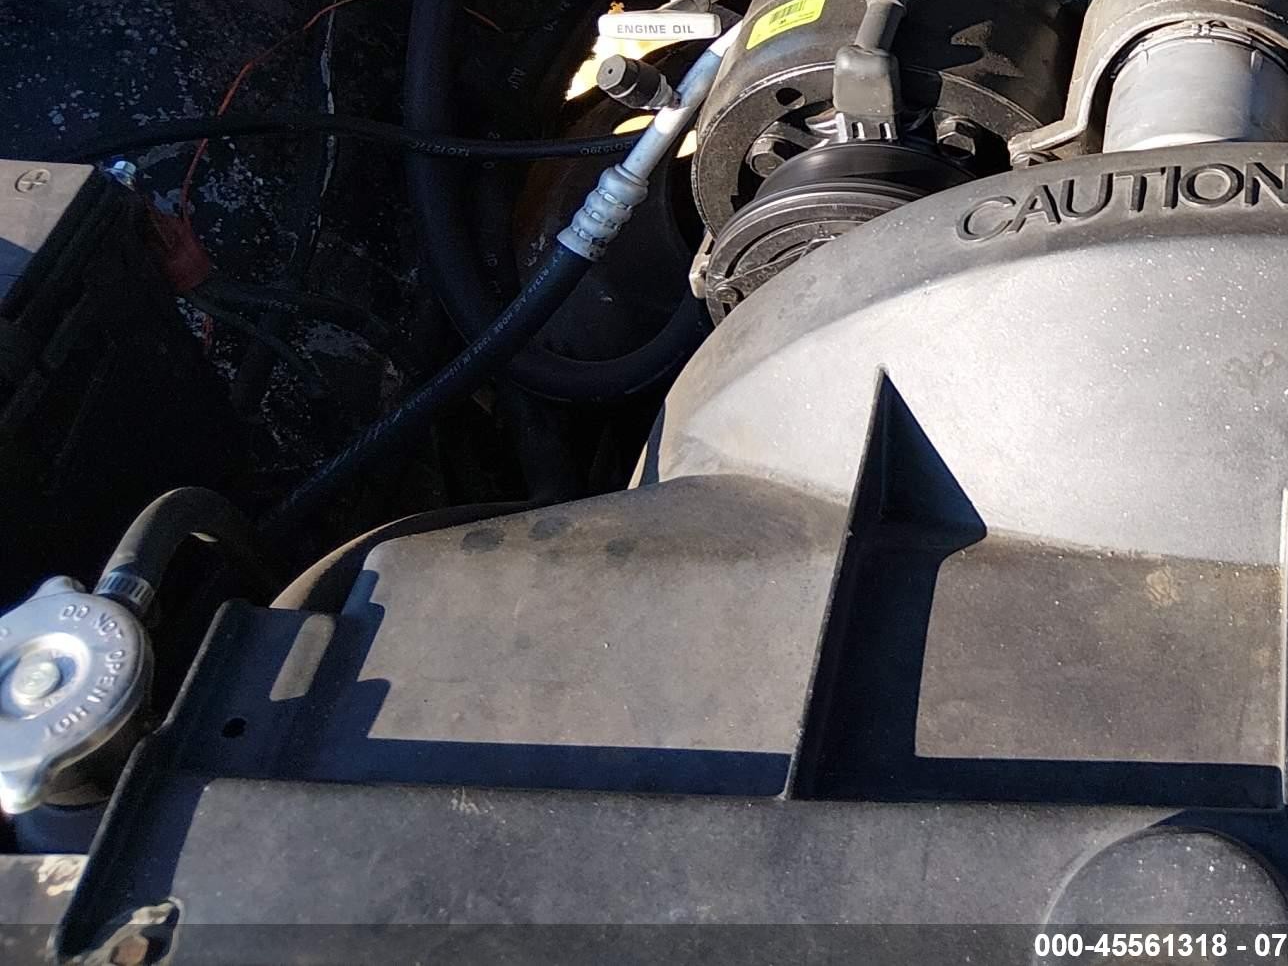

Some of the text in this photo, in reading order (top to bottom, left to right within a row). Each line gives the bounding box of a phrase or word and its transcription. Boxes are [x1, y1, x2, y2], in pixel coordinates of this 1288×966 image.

[616, 24, 695, 35] ENGINE OIL
[42, 604, 126, 740] DO NOT OPEN HOT
